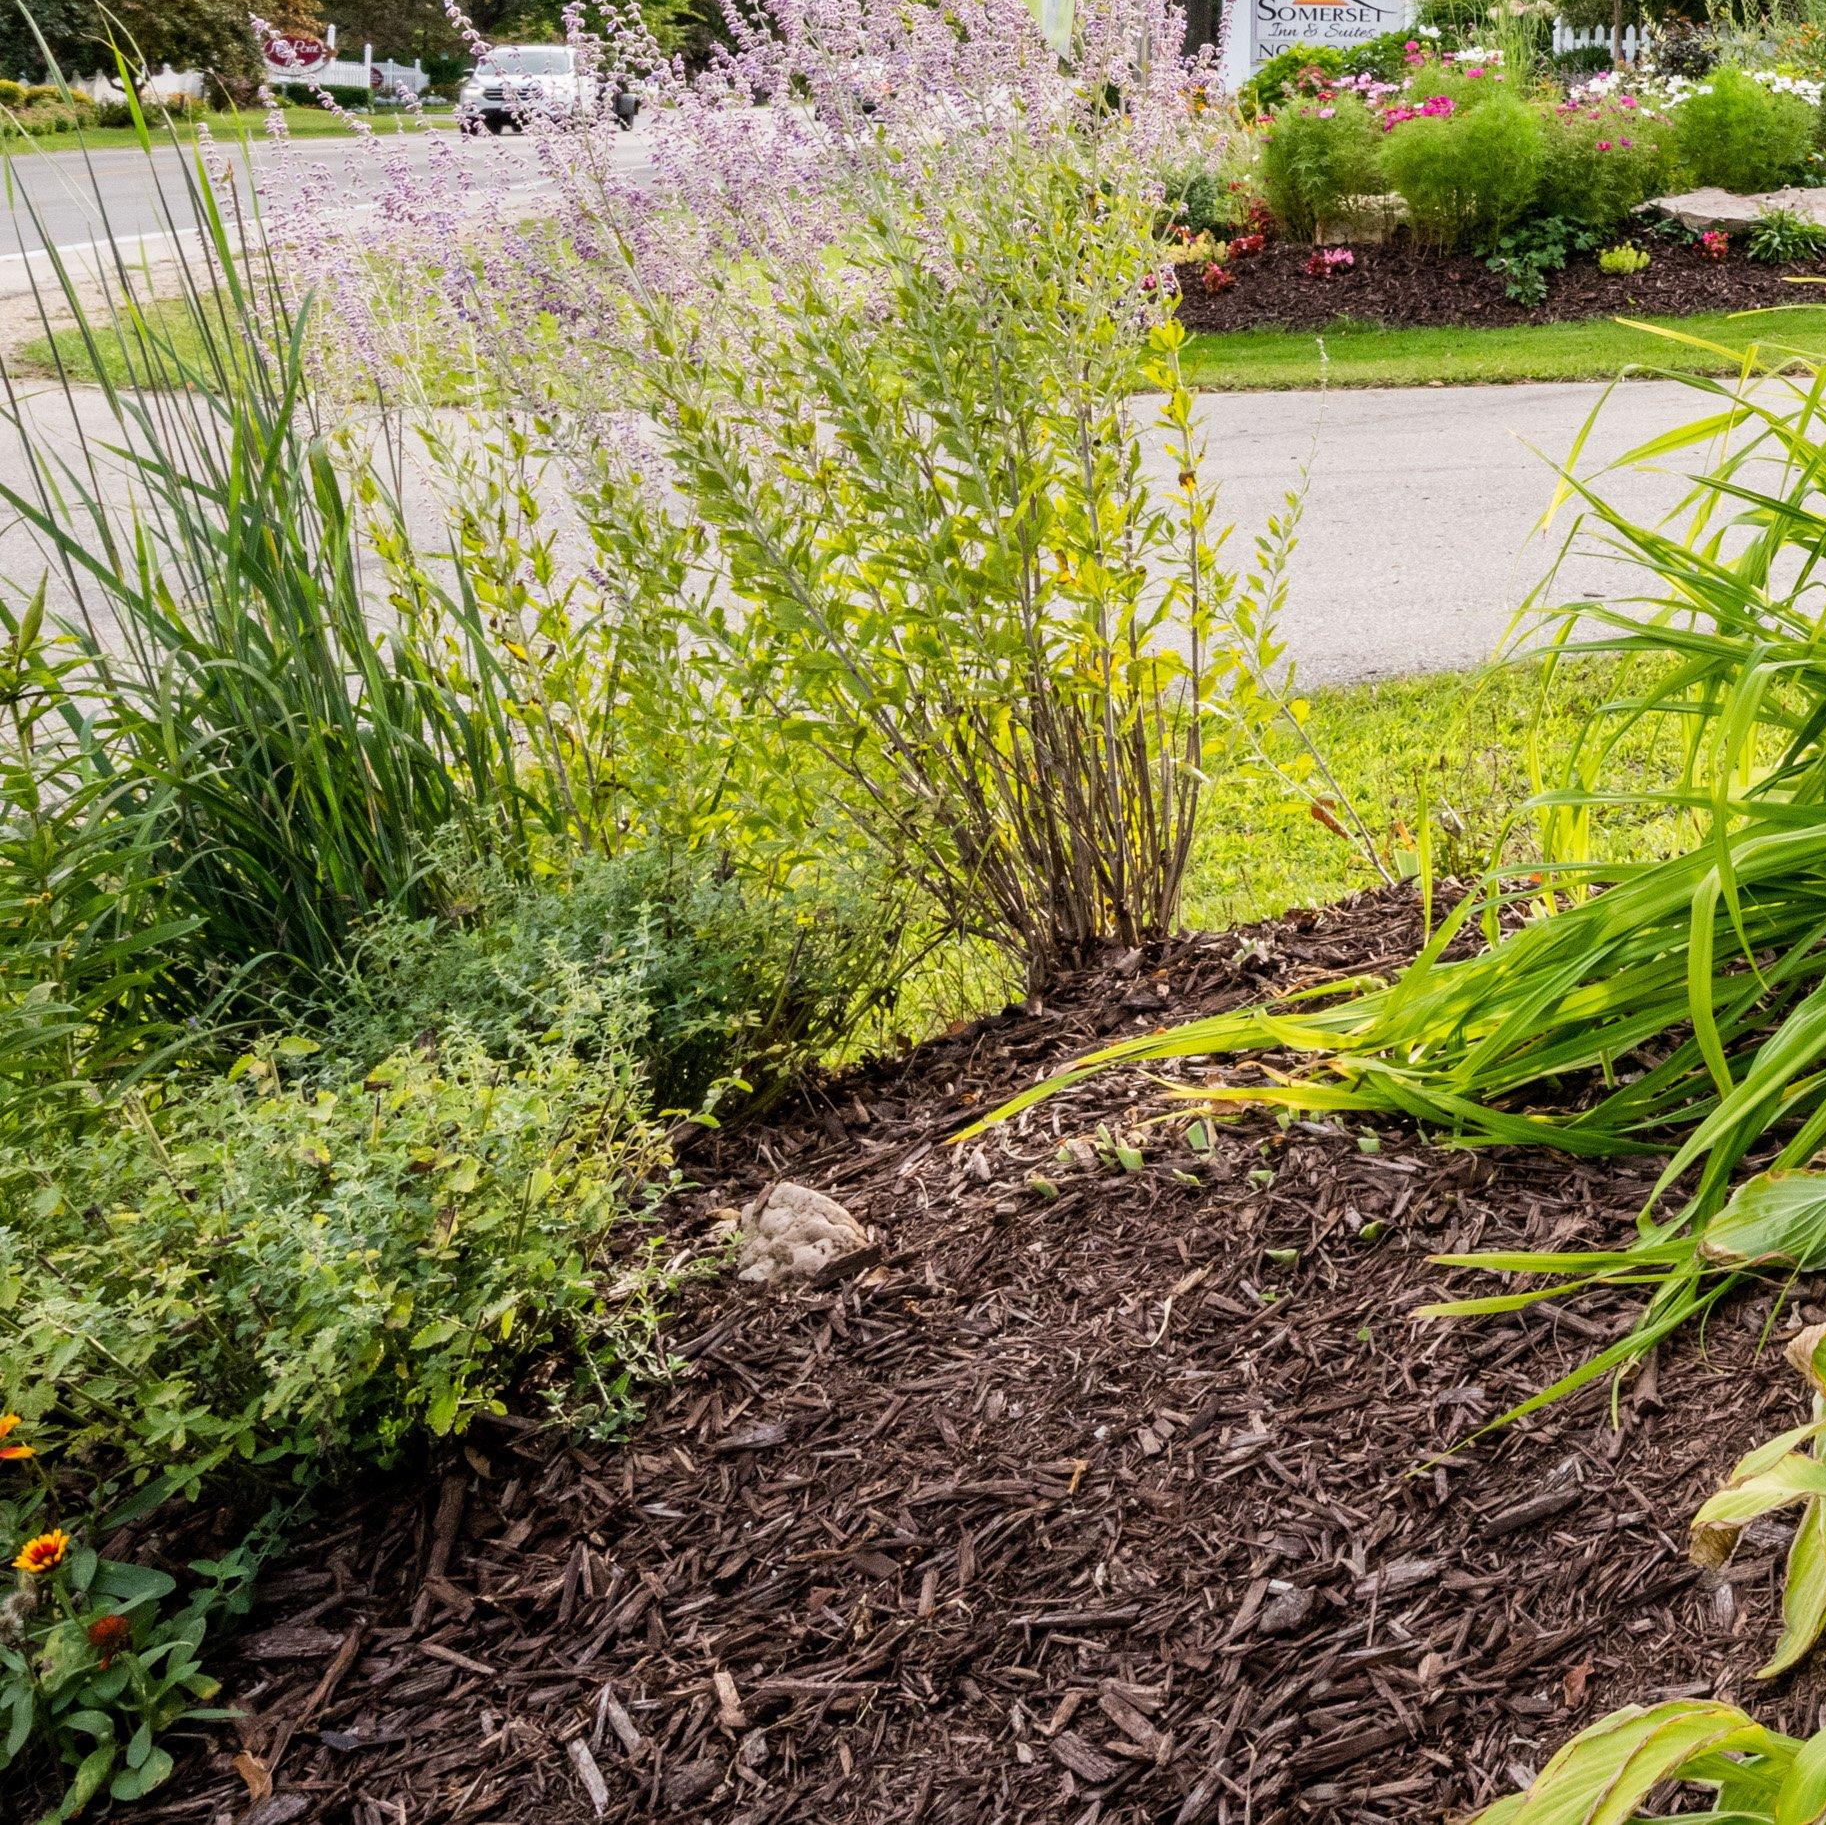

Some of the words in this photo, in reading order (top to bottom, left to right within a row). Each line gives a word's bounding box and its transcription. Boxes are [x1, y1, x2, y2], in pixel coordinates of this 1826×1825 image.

[1268, 22, 1298, 38] Inn
[1303, 22, 1319, 38] &
[1324, 22, 1378, 39] Suites
